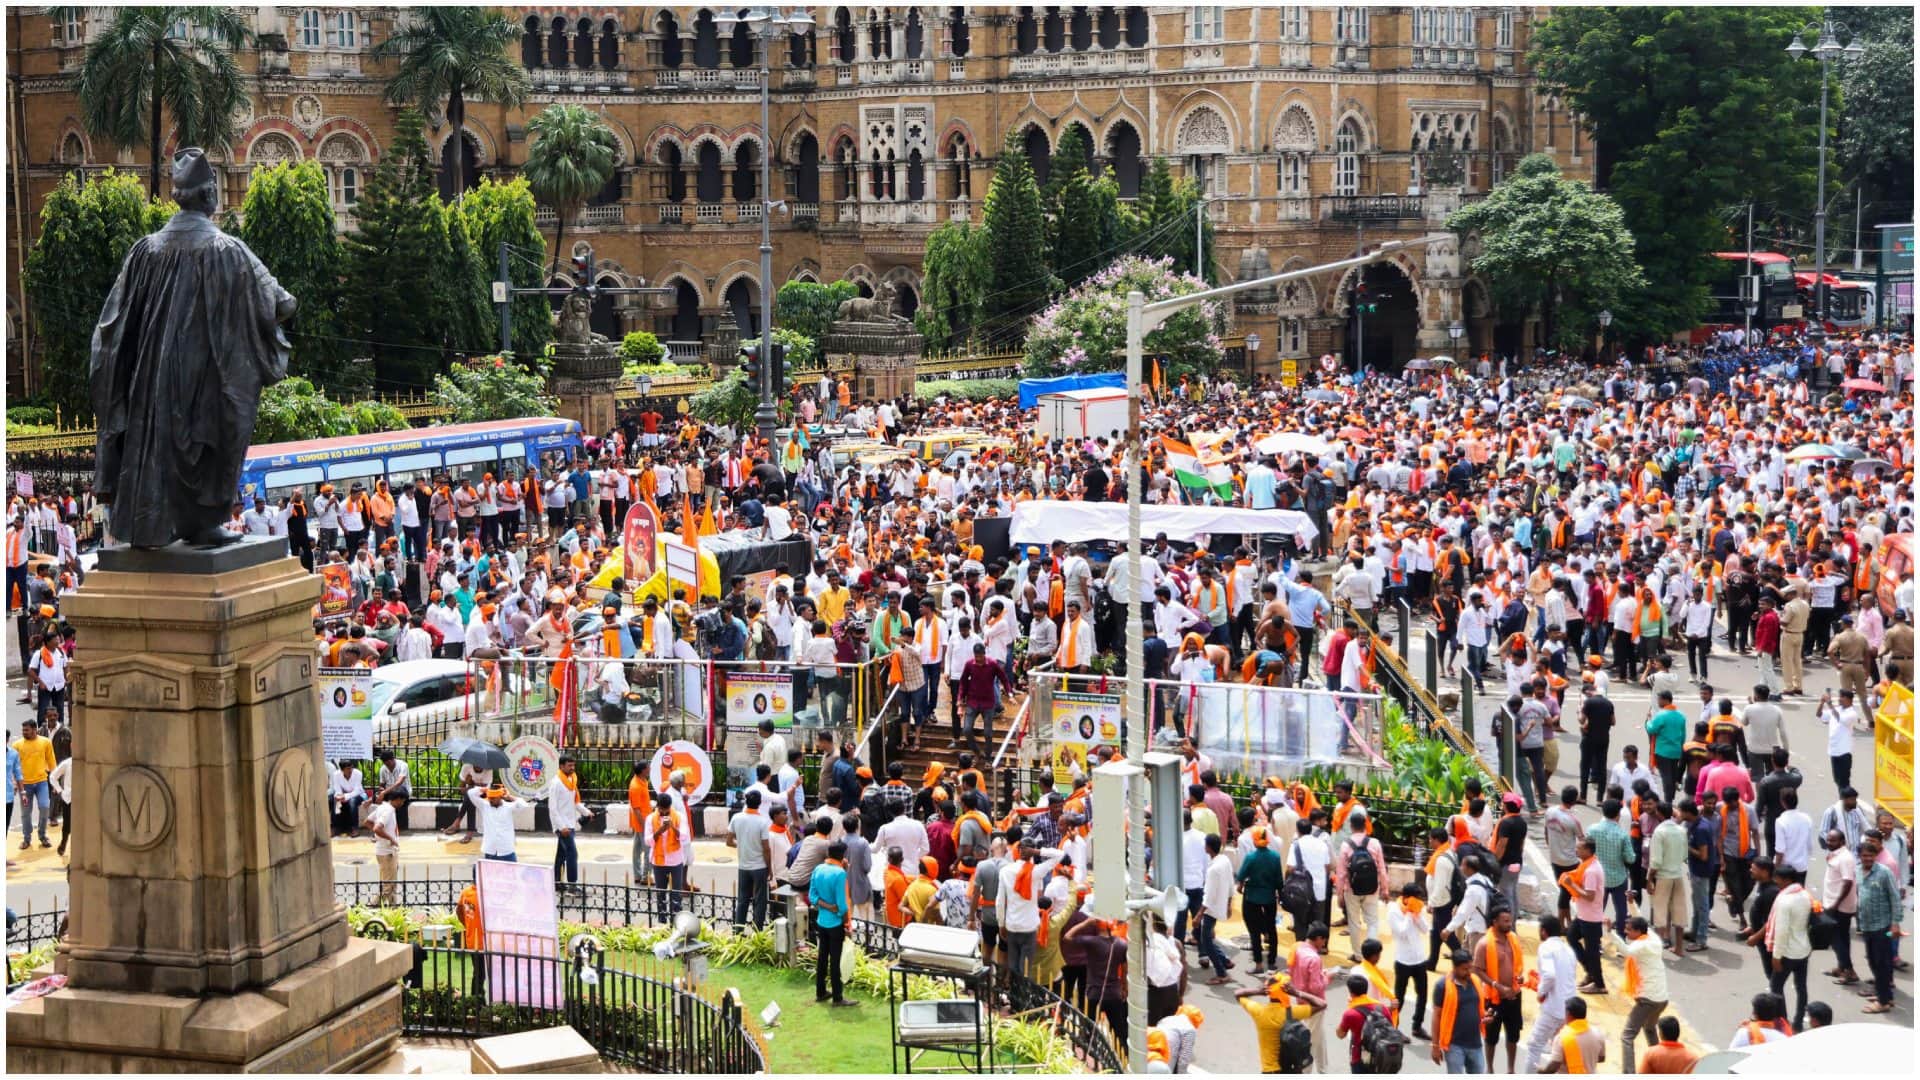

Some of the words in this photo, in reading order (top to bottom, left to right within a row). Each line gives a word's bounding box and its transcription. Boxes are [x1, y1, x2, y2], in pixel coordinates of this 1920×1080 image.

[296, 454, 330, 464] SUMMER
[116, 784, 151, 833] M
[284, 763, 310, 816] M
